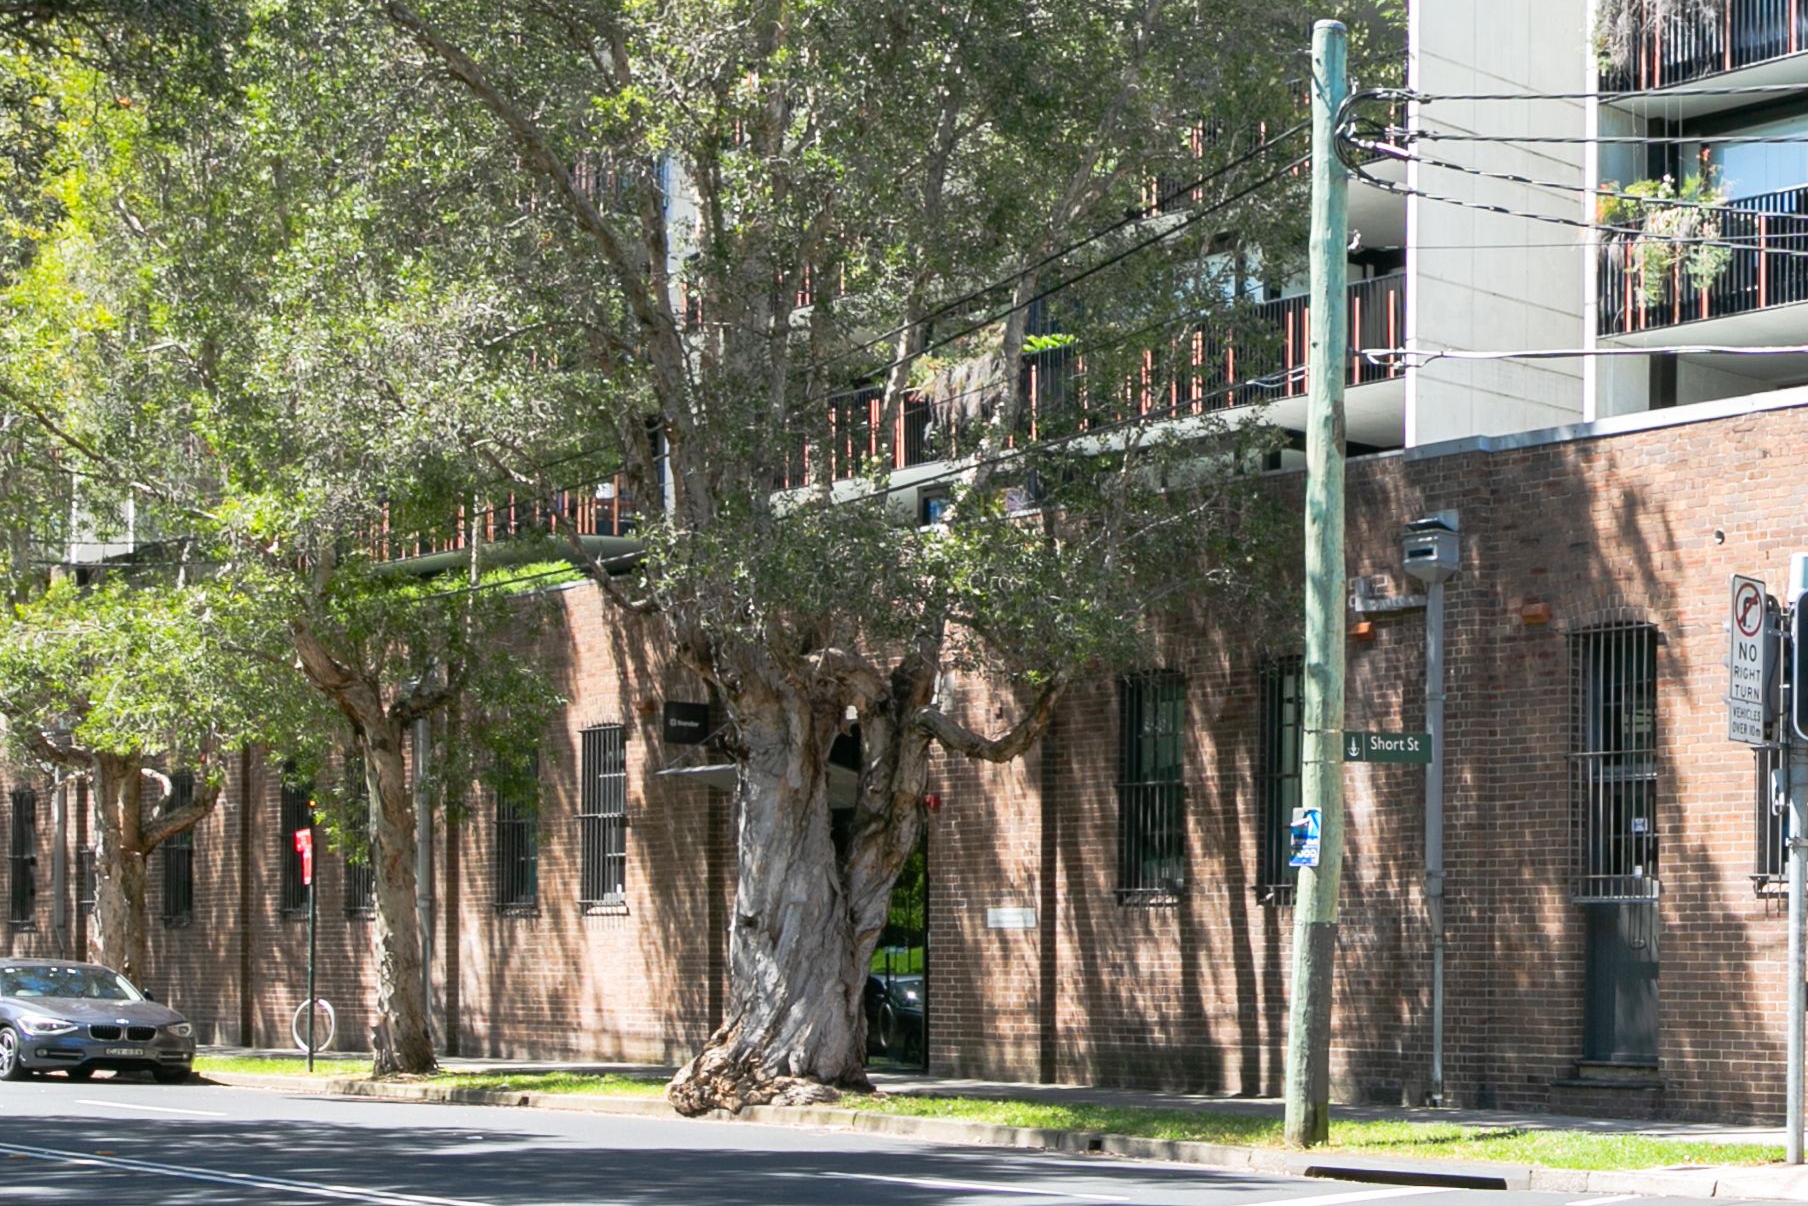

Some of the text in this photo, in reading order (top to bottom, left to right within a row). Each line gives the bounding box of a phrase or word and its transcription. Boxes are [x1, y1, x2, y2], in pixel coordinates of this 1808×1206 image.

[1738, 642, 1758, 662] NO
[1734, 666, 1761, 683] RIGHT
[1735, 684, 1760, 700] TURN
[1733, 706, 1761, 722] VEHICLES
[1732, 722, 1747, 735] OVER
[1370, 736, 1419, 751] Short St
